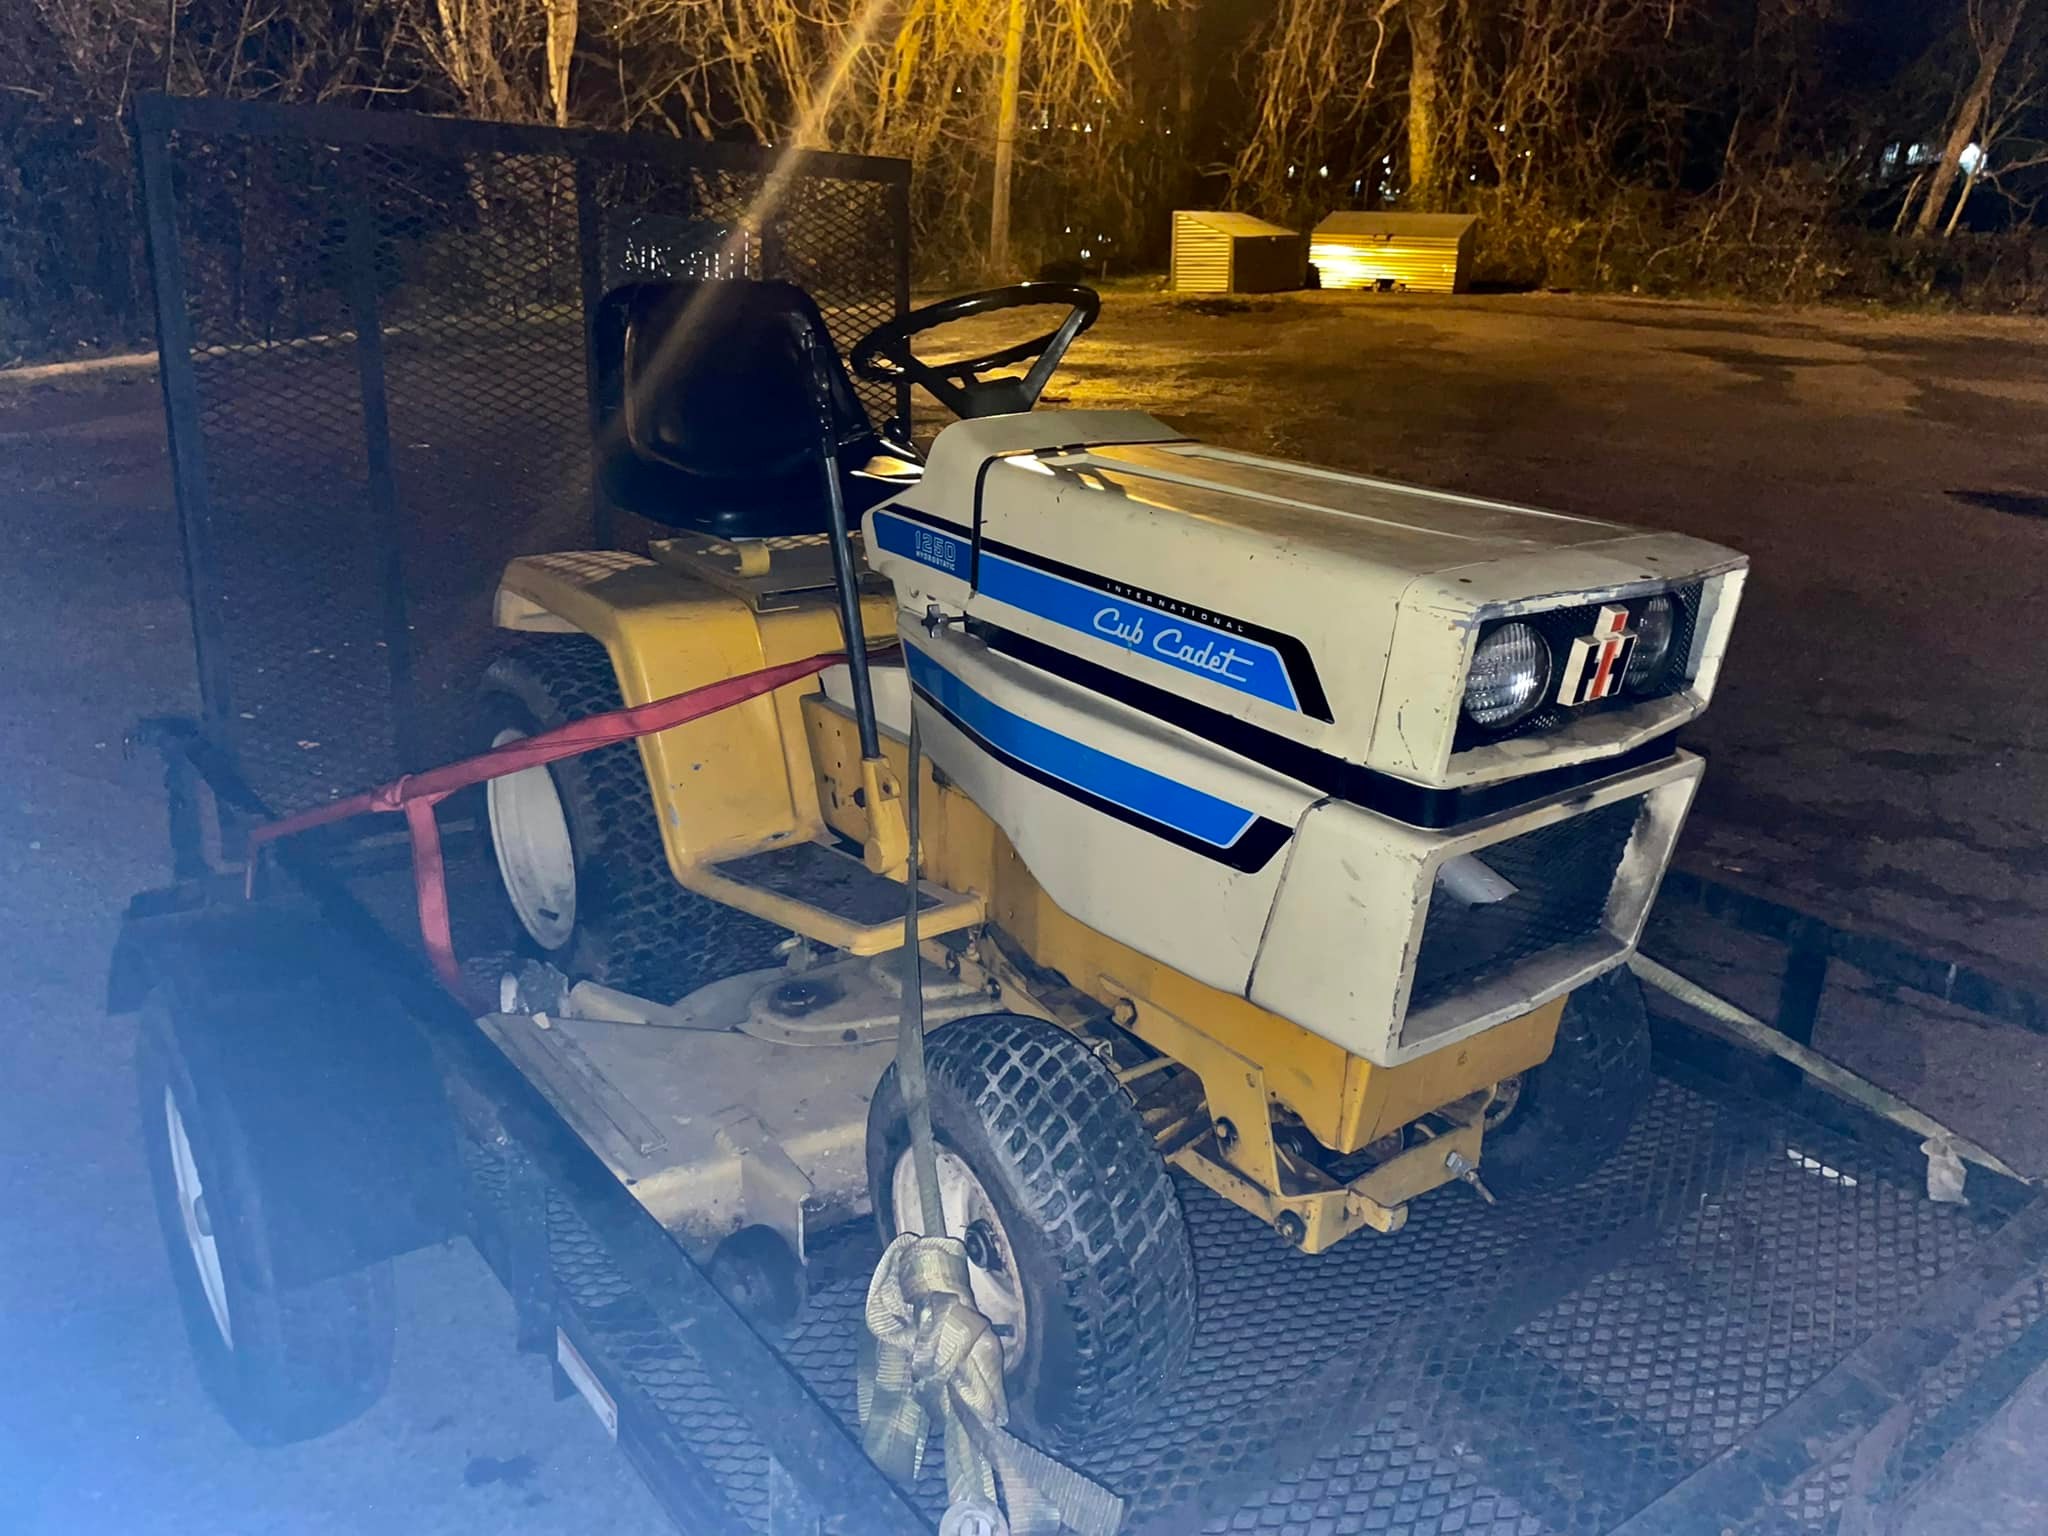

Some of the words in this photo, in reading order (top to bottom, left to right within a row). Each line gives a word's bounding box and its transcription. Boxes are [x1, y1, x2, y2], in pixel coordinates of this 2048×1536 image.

[914, 530, 956, 563] 1250
[1106, 582, 1244, 633] INTERNATIONAL
[1092, 607, 1144, 645] Cub
[1152, 628, 1255, 682] Cadet
